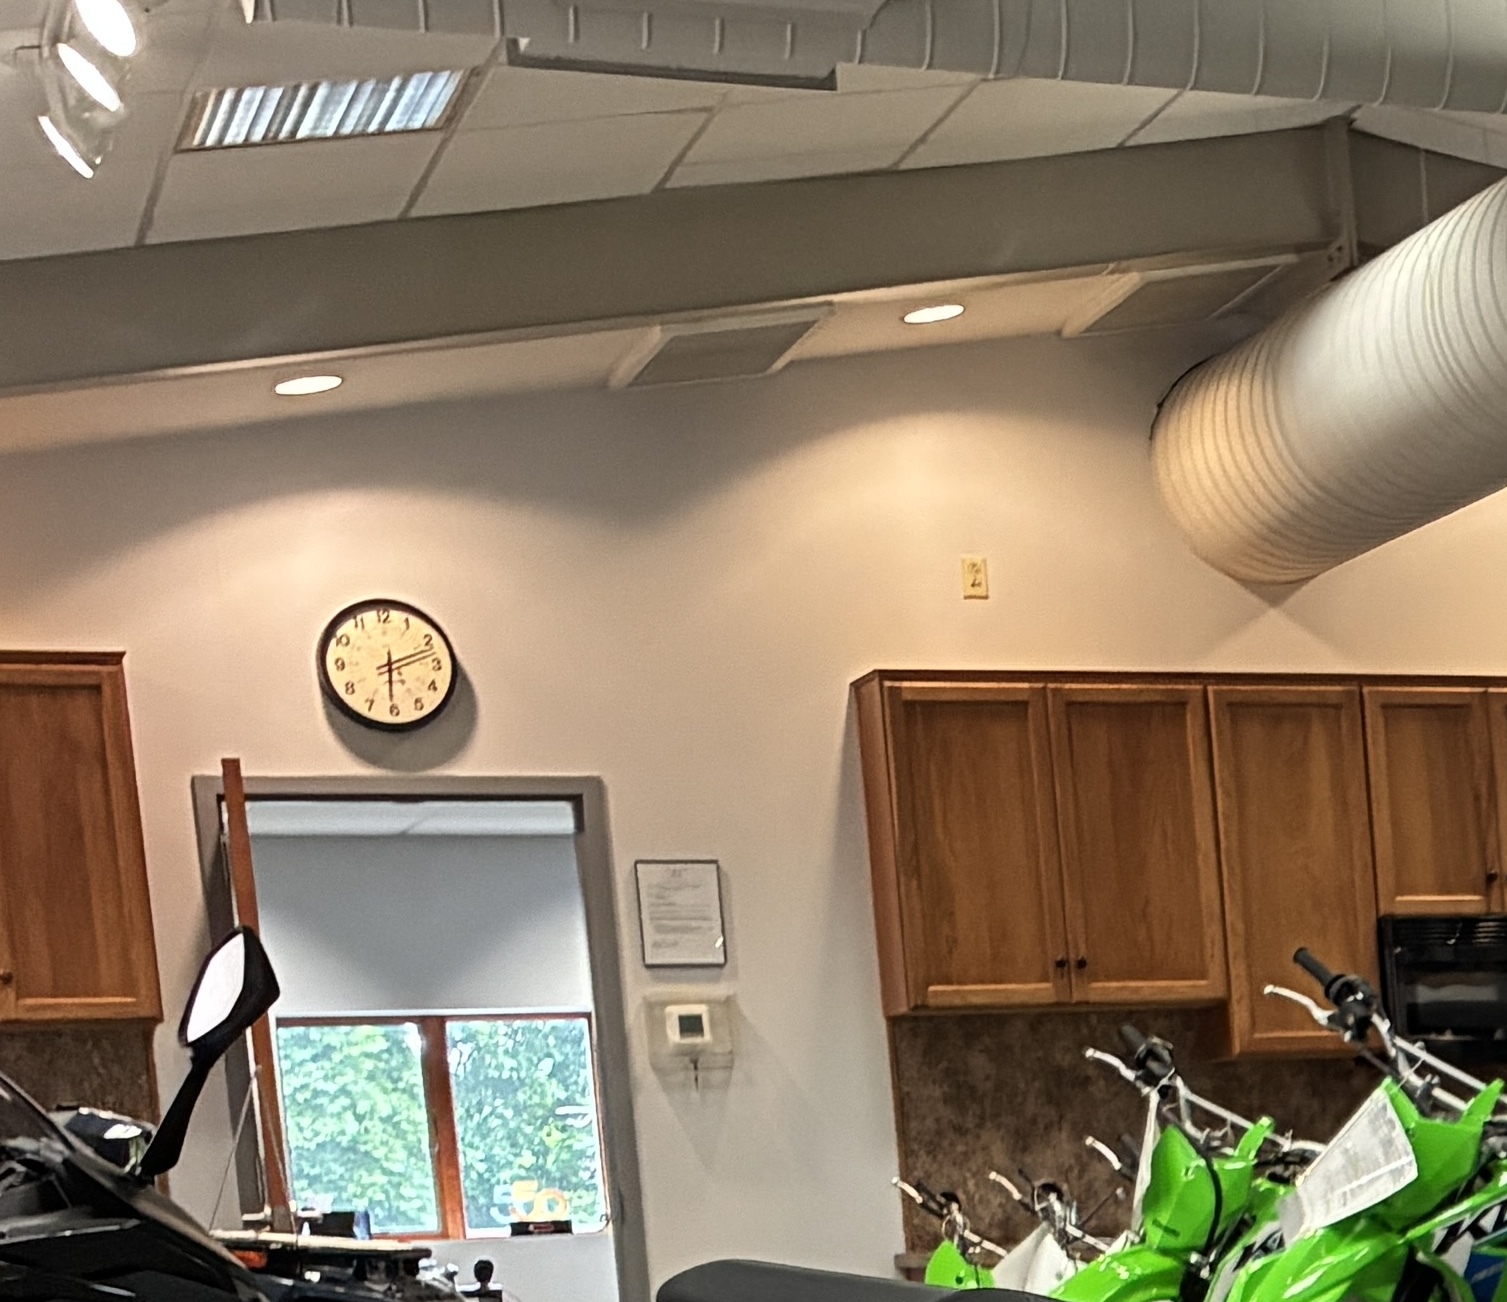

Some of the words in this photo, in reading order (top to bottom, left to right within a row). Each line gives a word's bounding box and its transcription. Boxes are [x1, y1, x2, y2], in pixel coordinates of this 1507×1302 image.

[376, 608, 390, 623] 12
[353, 615, 364, 630] 11
[335, 633, 350, 646] 10
[423, 634, 433, 646] 2
[334, 658, 345, 670] 9
[431, 657, 441, 670] 3
[344, 681, 355, 694] 8
[427, 679, 437, 691] 4
[365, 698, 374, 711] 7
[389, 703, 400, 716] 6
[414, 697, 424, 710] 5
